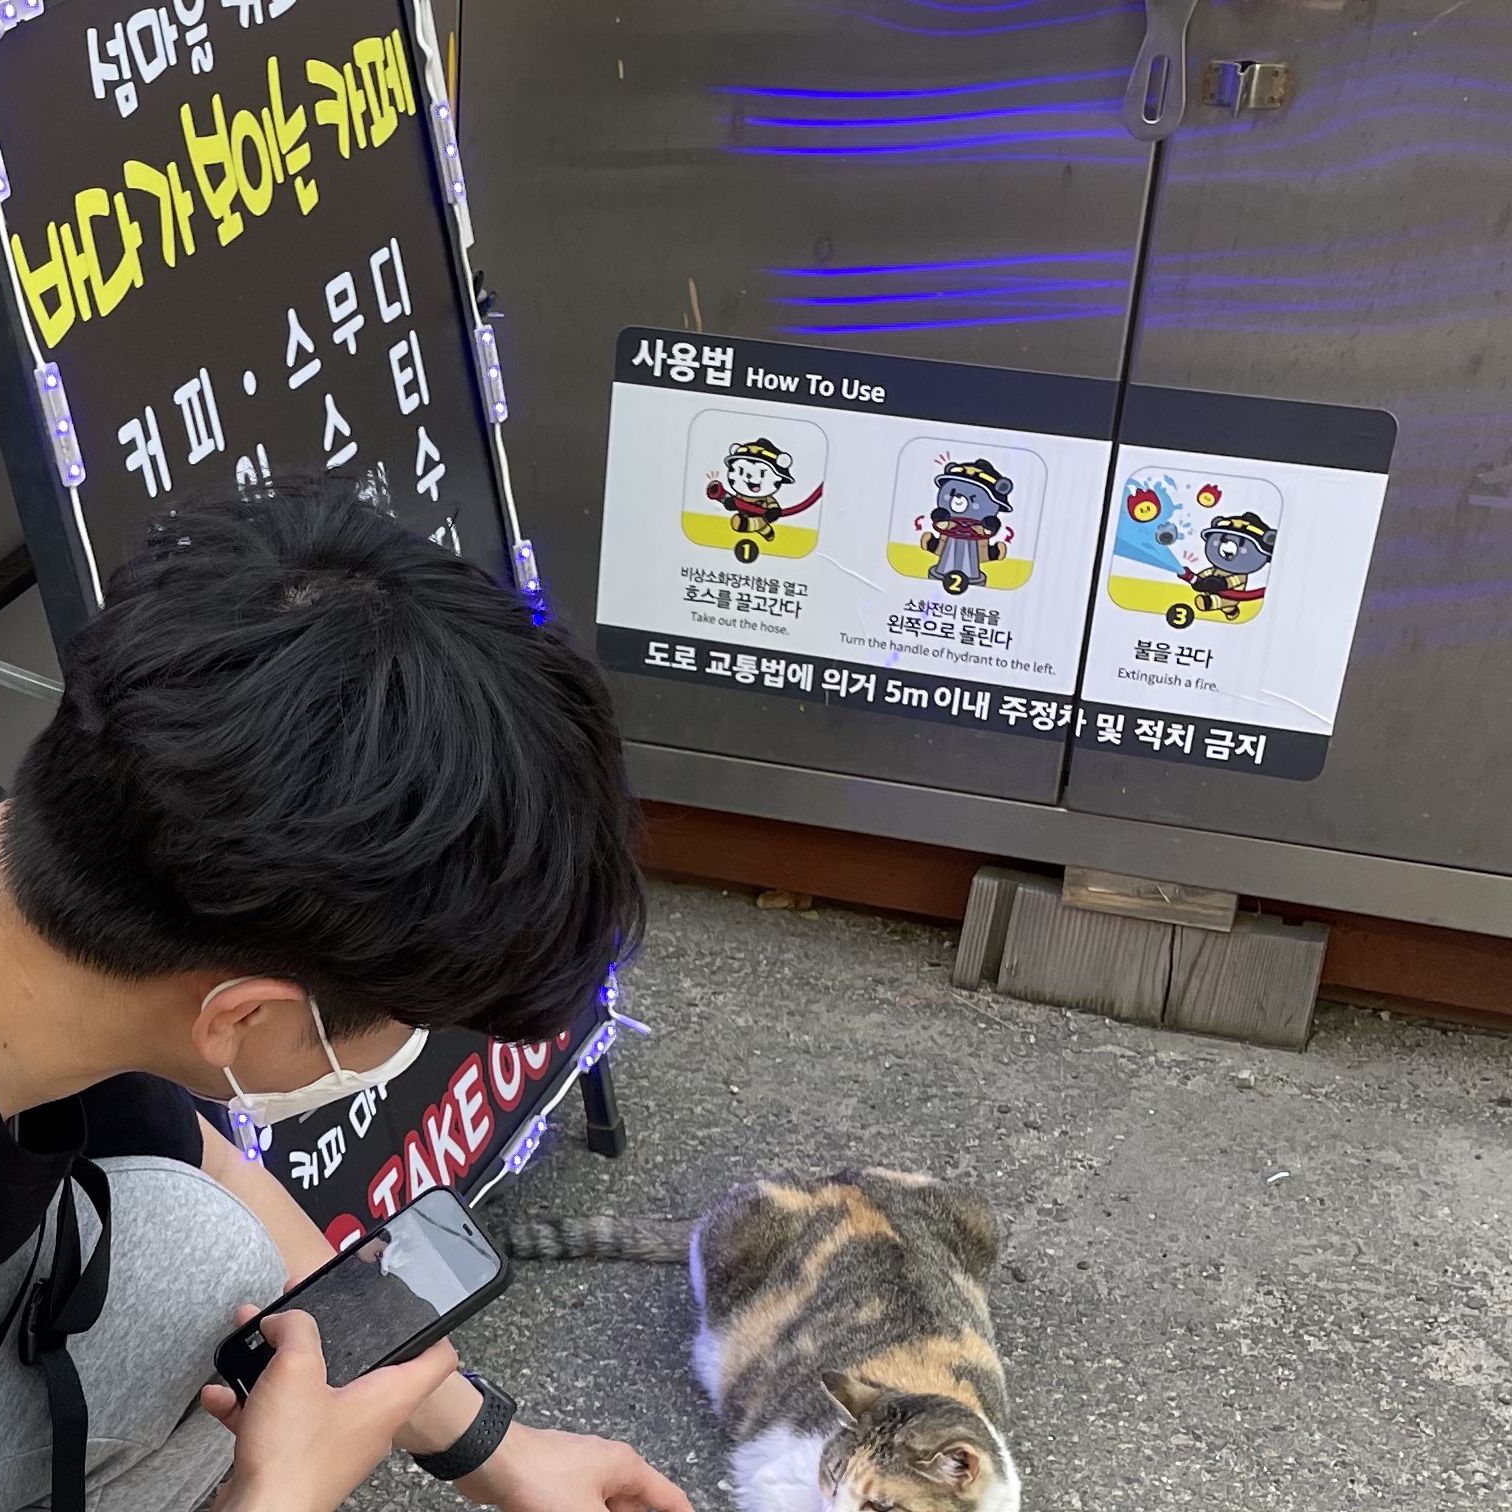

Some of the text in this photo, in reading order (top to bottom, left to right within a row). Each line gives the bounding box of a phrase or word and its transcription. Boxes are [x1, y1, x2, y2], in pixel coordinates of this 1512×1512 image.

[87, 0, 214, 118] 섬마을
[305, 28, 417, 159] 카페
[286, 237, 413, 390] 스무디
[632, 338, 886, 403] 사용법 How To Use
[208, 329, 430, 512] 이스티
[742, 543, 750, 560] 1
[680, 566, 809, 597] 비상소화장치함을 열고
[948, 575, 962, 592] 2
[683, 585, 803, 619] 호스를 끌고간다
[903, 599, 1001, 626] 소화전의 핸들을
[1173, 607, 1188, 626] 3
[690, 611, 790, 636] Take out the hose.
[886, 614, 1014, 650] 왼쪽으로 돌린다
[839, 632, 1057, 676] Turn the handle of hydrant to the left.
[1133, 639, 1214, 669] 불을 끈다
[1117, 667, 1220, 693] Extinguish a fire.
[644, 641, 698, 672] 도로
[705, 650, 815, 693] 교통법에
[821, 668, 877, 703] 의거
[998, 695, 1088, 737] 주정차
[1095, 713, 1126, 745] 및
[1134, 717, 1196, 754] 적치
[1204, 728, 1267, 765] 금지
[289, 1125, 347, 1190] 커피
[371, 1062, 491, 1218] TAKE
